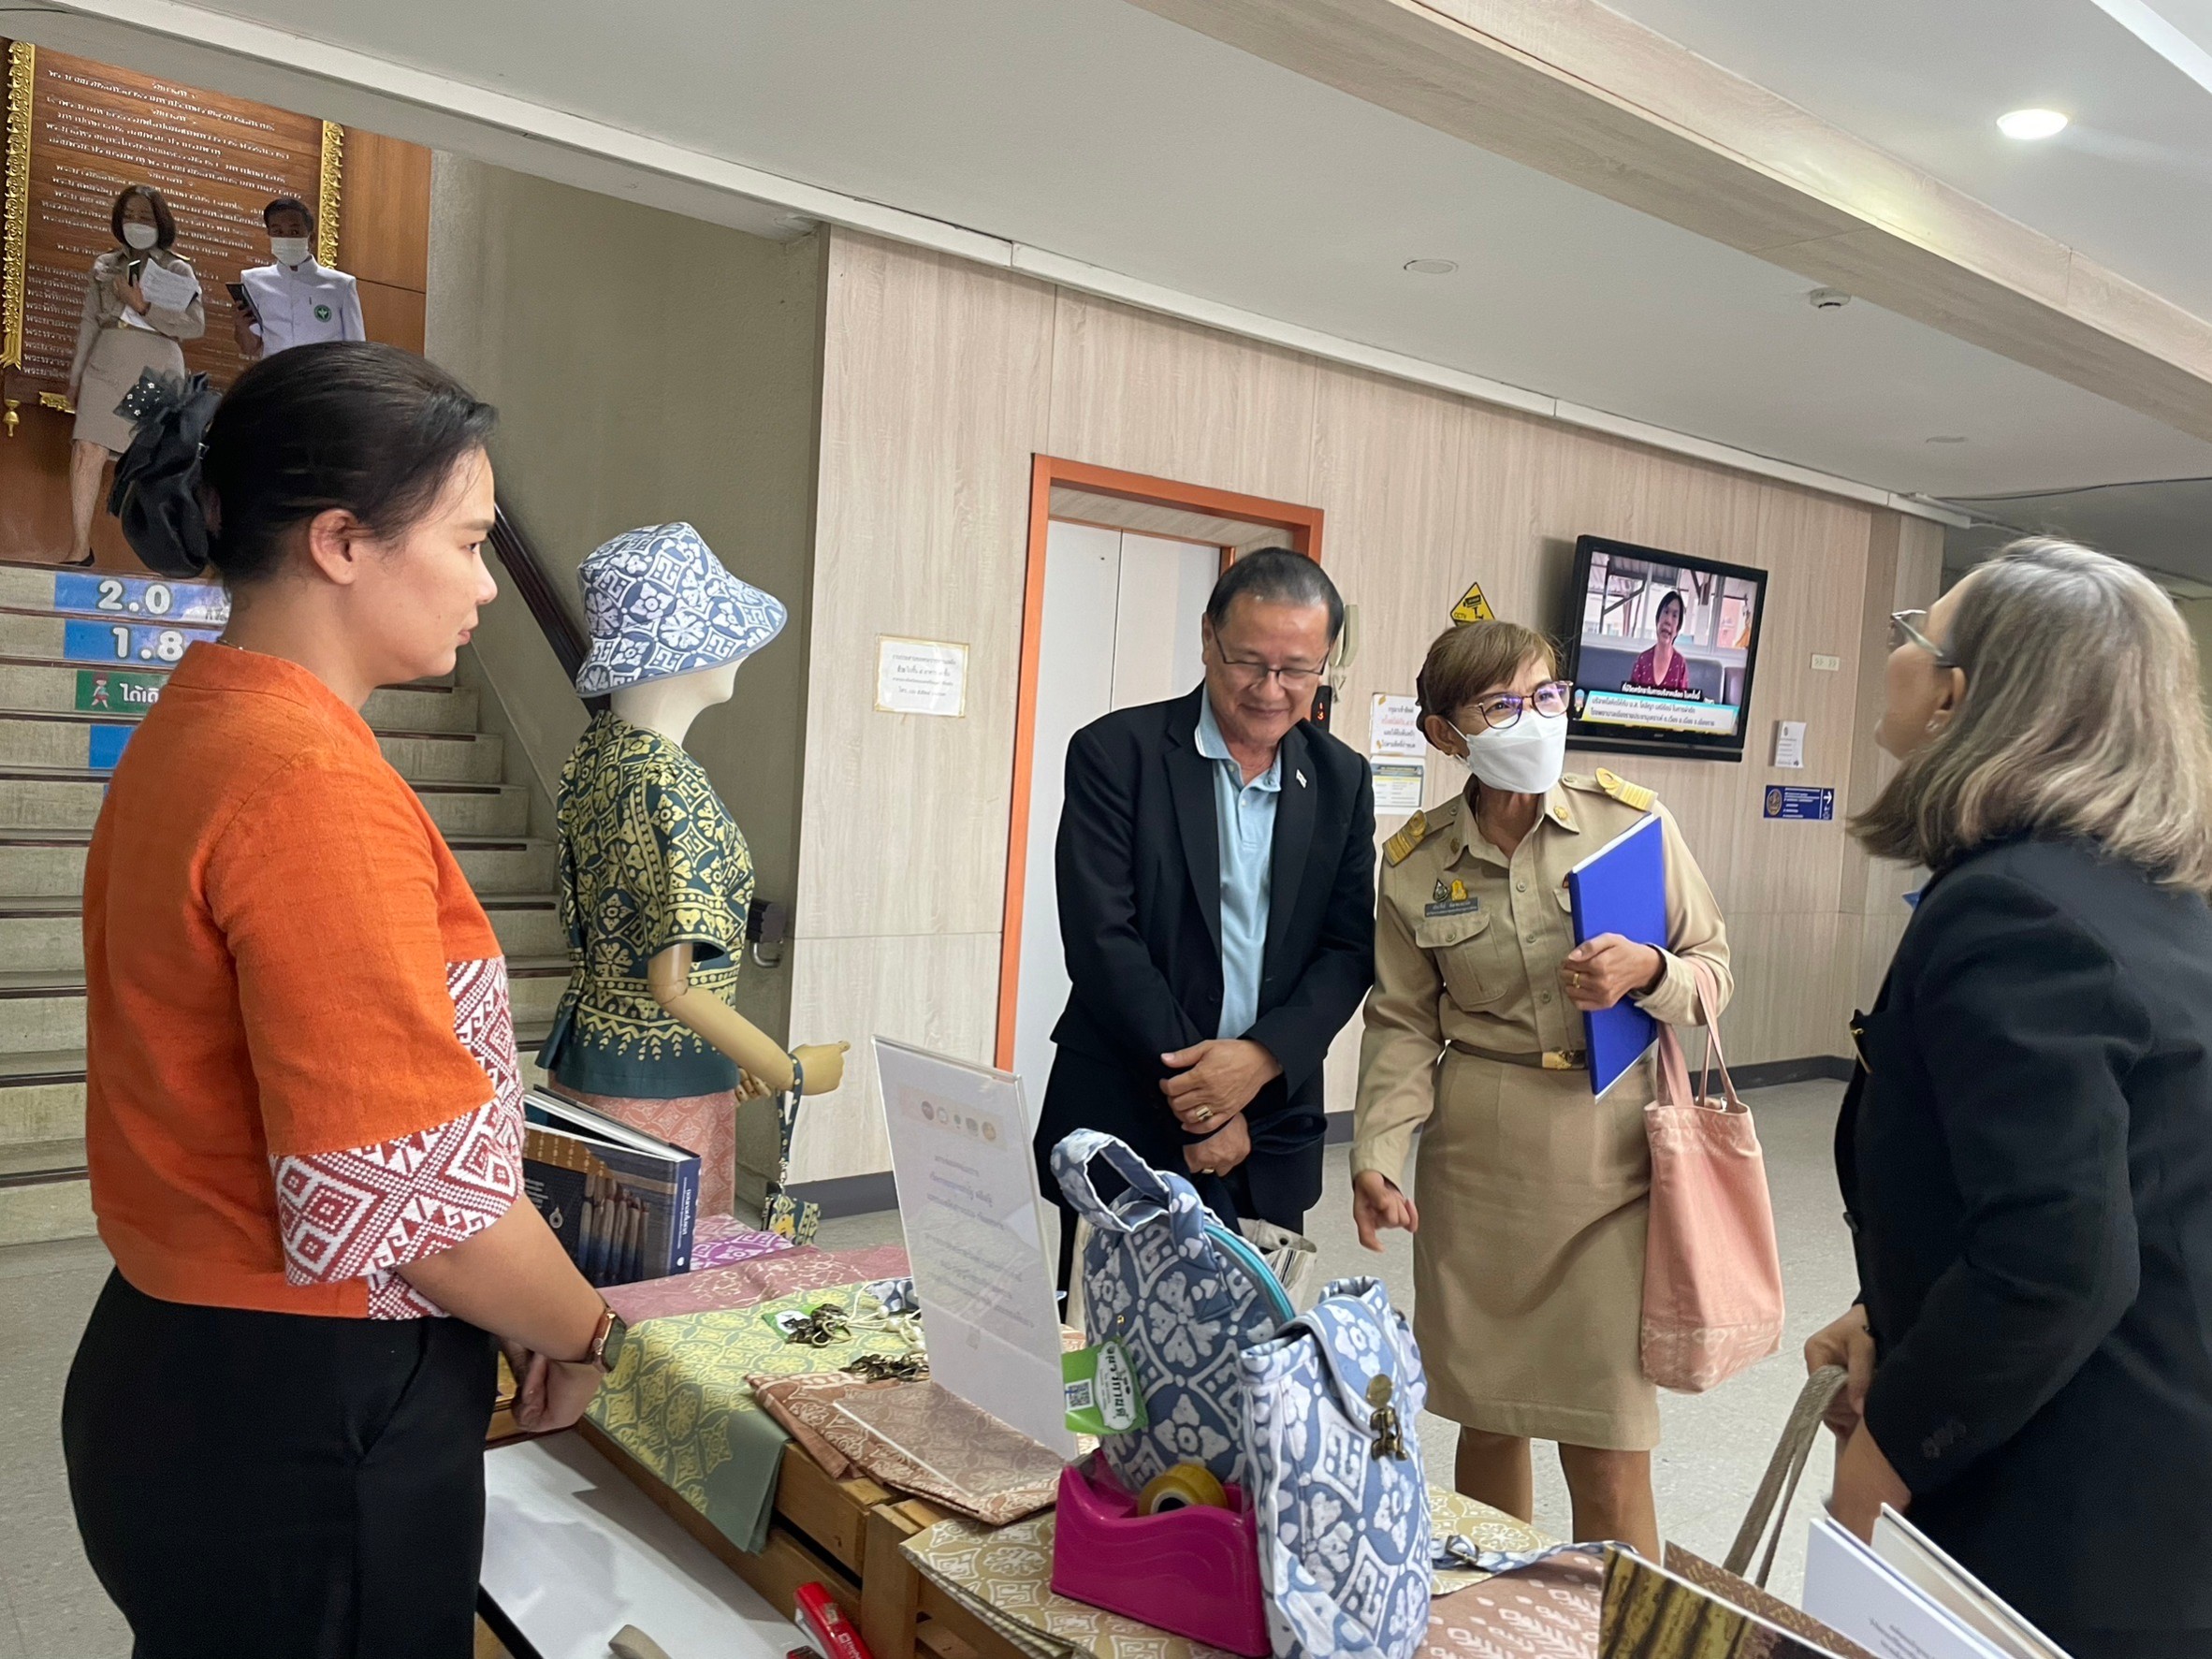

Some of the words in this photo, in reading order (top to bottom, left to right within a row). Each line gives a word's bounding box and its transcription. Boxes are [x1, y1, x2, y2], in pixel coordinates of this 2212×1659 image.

[98, 580, 170, 615] 2.0
[112, 627, 183, 662] 1.8
[119, 682, 159, 703] ได้เดิ
